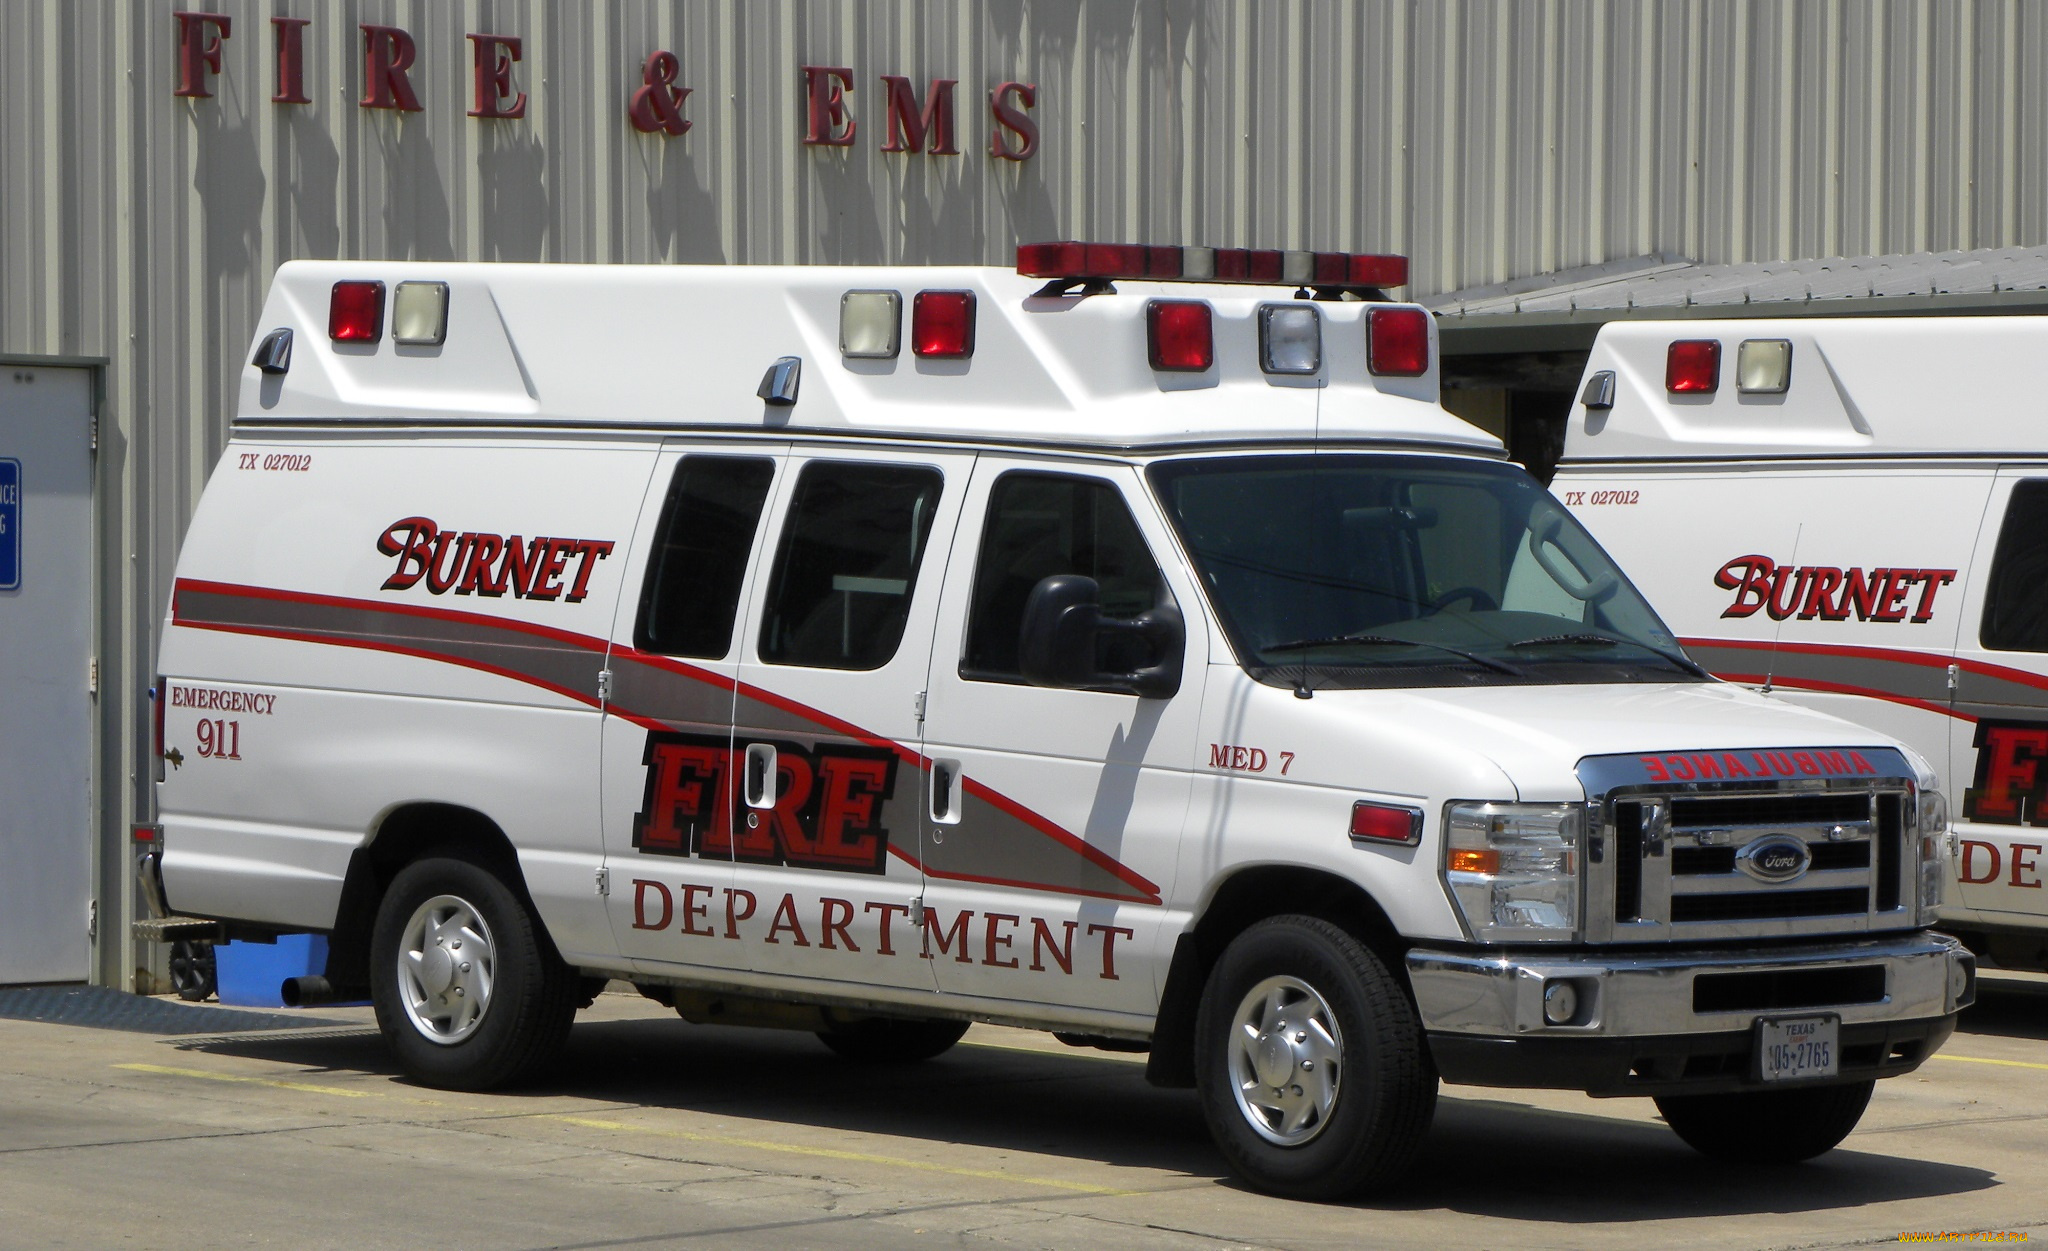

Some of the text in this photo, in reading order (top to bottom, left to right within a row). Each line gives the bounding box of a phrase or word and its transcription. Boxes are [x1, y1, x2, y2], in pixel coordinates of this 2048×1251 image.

[173, 12, 1040, 161] FIRE & EMS
[238, 453, 311, 472] TX 027012
[1565, 490, 1639, 506] TX 027012
[376, 516, 615, 603] BURNET
[1713, 554, 1957, 624] BURNET
[171, 686, 277, 715] EMERGENCY
[196, 718, 242, 761] 911
[1208, 743, 1296, 776] MED 7
[633, 729, 900, 875] FIRE
[1765, 850, 1796, 869] Ford
[1957, 839, 2043, 889] DE
[631, 878, 1134, 981] DEPARTMENT
[1786, 1023, 1815, 1036] TEXAS
